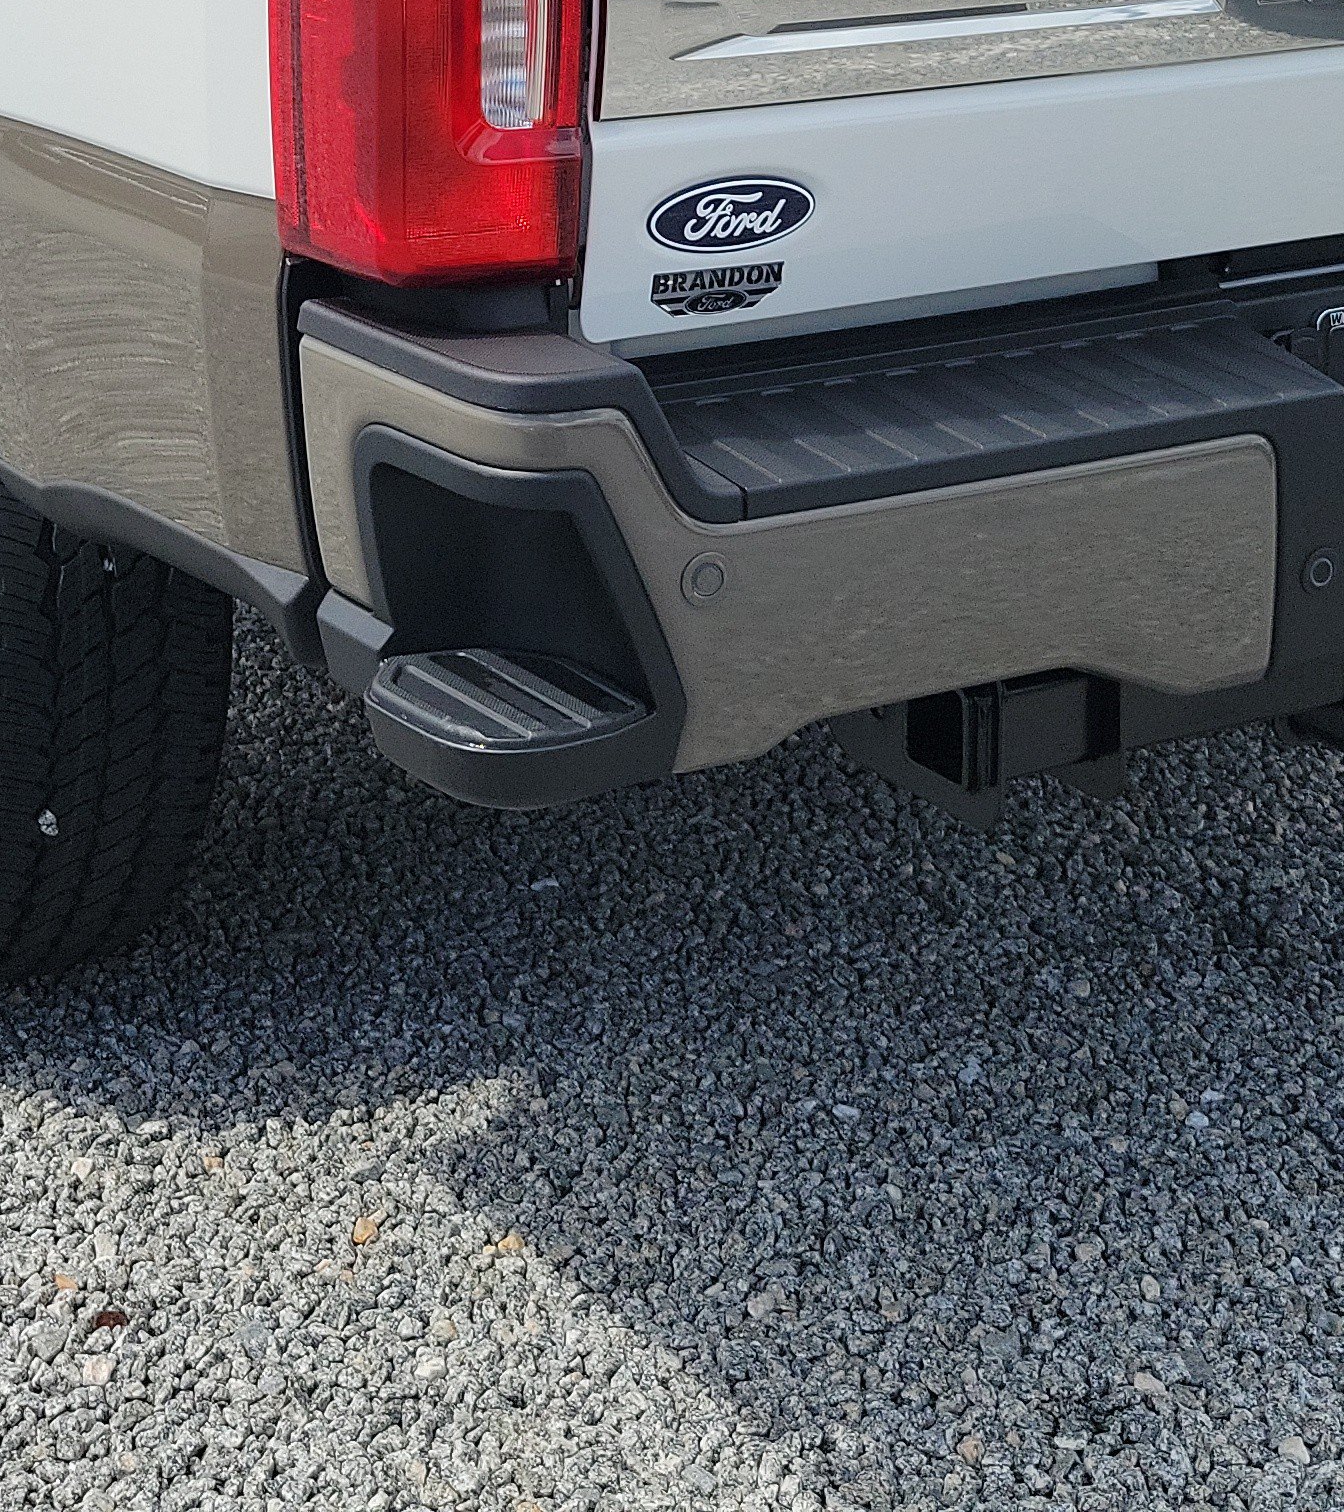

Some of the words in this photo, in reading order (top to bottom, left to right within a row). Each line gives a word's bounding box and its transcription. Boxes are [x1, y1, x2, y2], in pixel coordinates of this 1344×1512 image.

[683, 191, 787, 242] Ford
[654, 262, 783, 295] BRANDON
[697, 293, 734, 312] Ford
